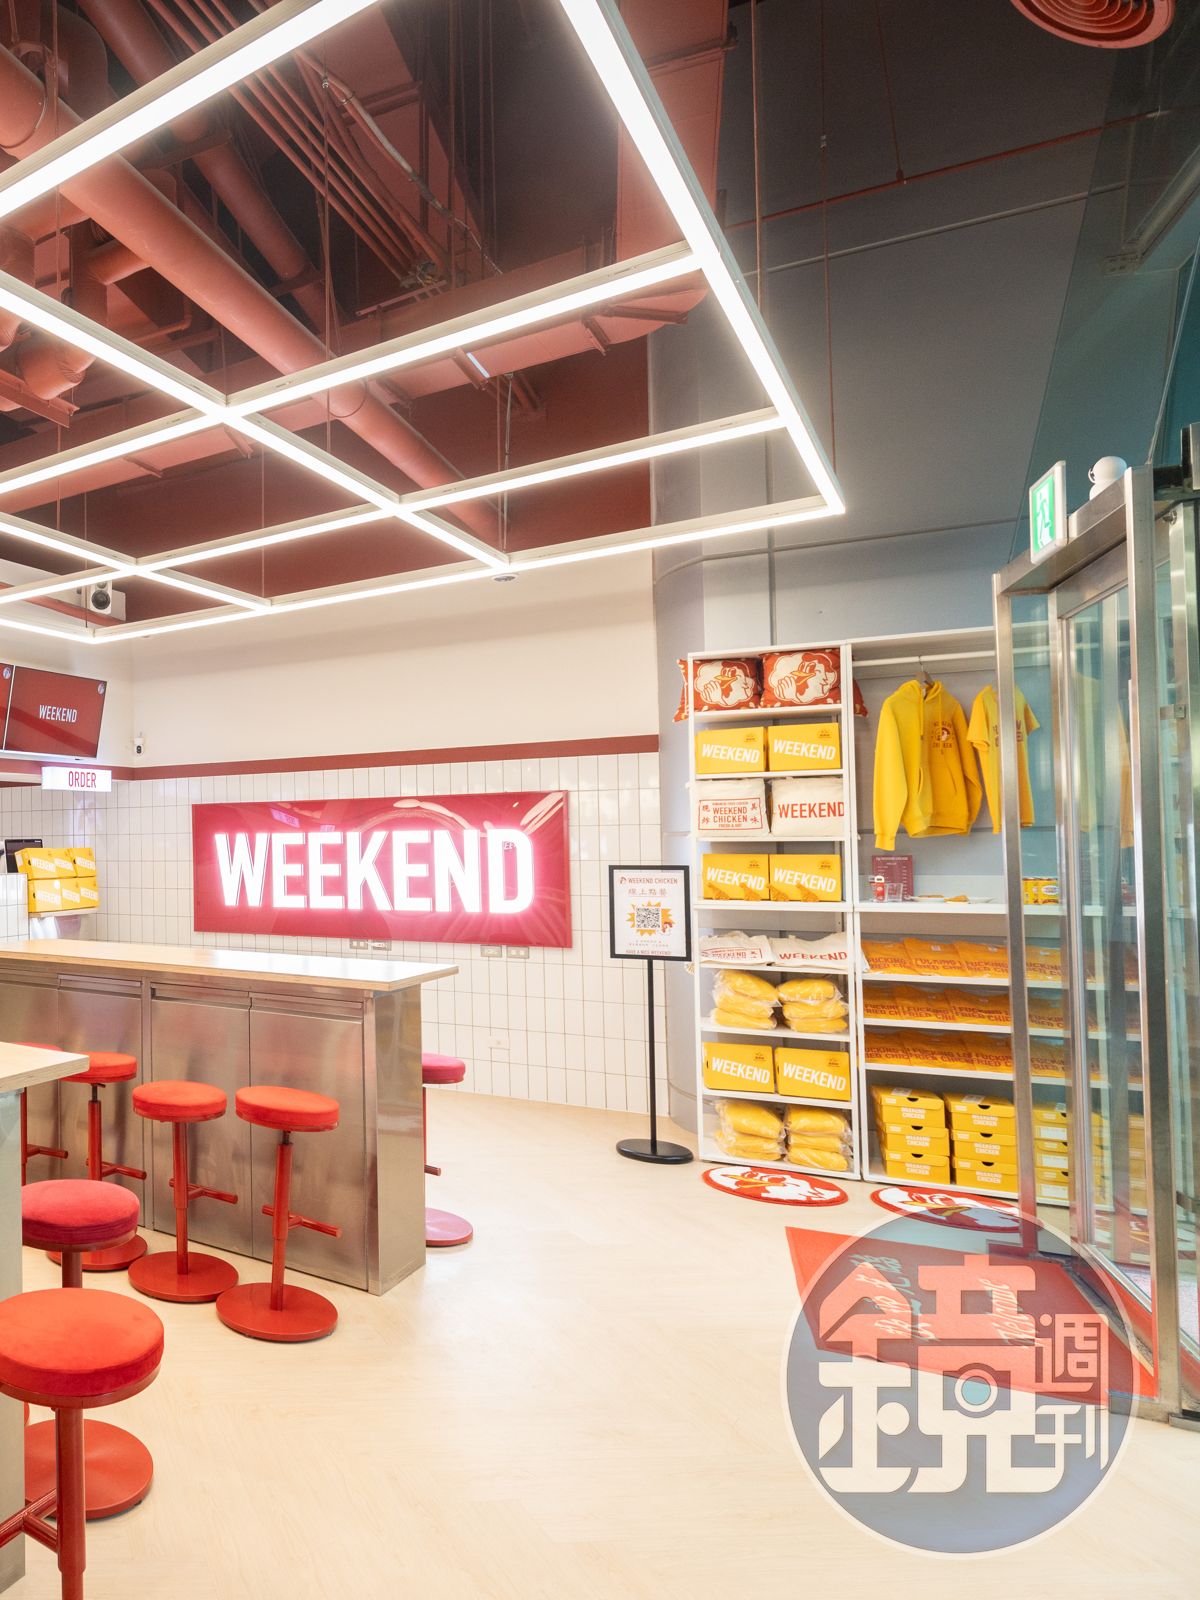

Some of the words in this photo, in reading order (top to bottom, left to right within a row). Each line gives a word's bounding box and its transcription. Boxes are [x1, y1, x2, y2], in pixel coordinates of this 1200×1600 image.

[39, 704, 78, 723] WEEKEND
[701, 742, 761, 764] WEEKEND
[773, 739, 837, 761] WEEKEND
[68, 770, 97, 788] ORDER
[712, 806, 748, 815] WEEKEND
[713, 815, 748, 824] CHICKEN
[778, 801, 845, 819] WEEKEND
[215, 828, 535, 914] WEEKEND
[773, 867, 837, 893] WEEKEND
[779, 951, 848, 961] WEEKEND
[711, 1056, 771, 1084] WEEKEND
[783, 1062, 847, 1091] WEEKEND
